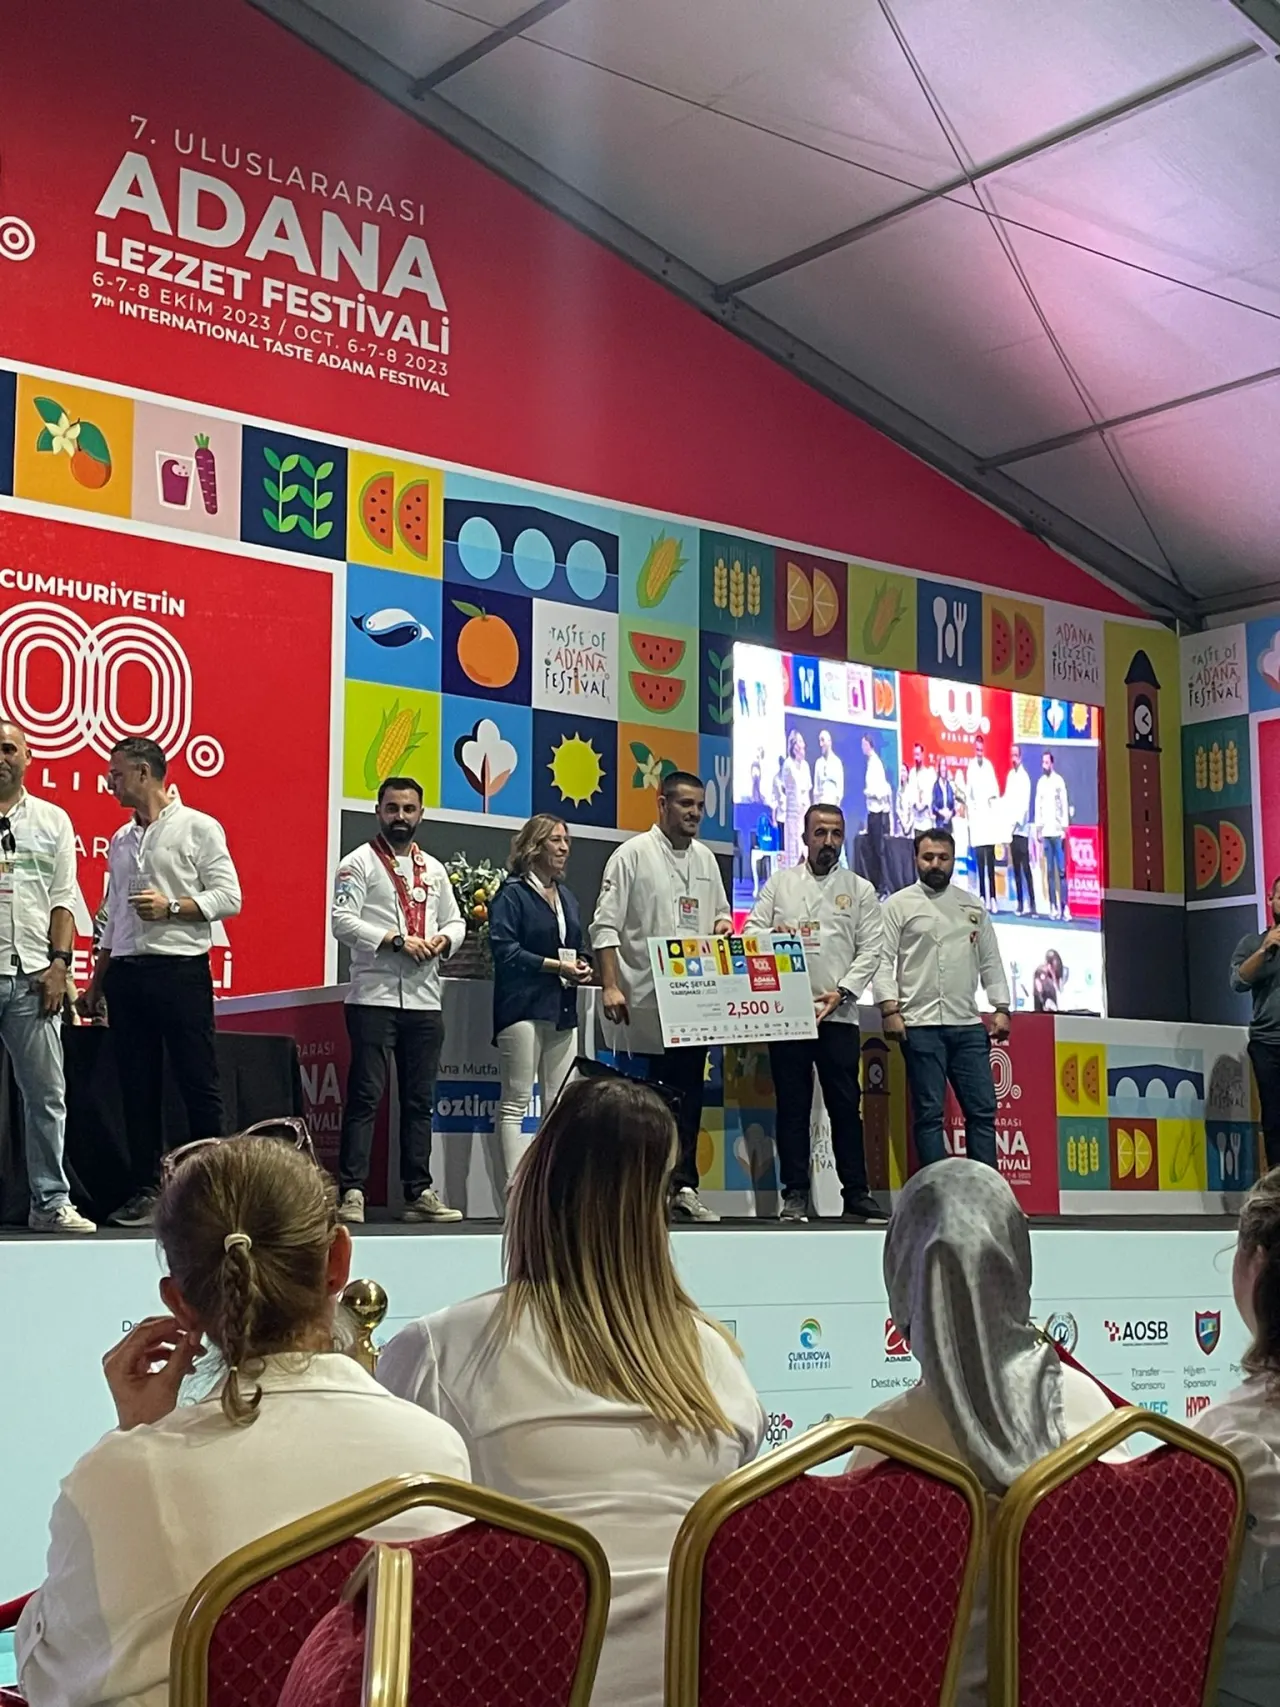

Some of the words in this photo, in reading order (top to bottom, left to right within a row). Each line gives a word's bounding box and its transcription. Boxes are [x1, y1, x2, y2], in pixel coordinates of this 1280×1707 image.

[130, 114, 156, 144] 7.
[174, 128, 426, 226] ULUSLARARASI
[94, 150, 449, 312] ADANA
[95, 231, 251, 301] LEZZET
[261, 279, 450, 355] FESTİVALİ
[92, 271, 150, 300] 6-7-8
[159, 288, 214, 317] EKİM
[222, 304, 271, 332] 2023
[293, 324, 340, 350] OCT.
[347, 337, 397, 364] 6-7-8
[404, 351, 449, 377] 2023
[91, 292, 115, 309] 7th
[118, 299, 260, 350] INTERNATIONAL
[262, 337, 314, 364] TASTE
[317, 353, 376, 379] ADANA
[379, 368, 450, 397] FESTIVAL
[0, 568, 186, 618] CUMHURİYETİN
[554, 647, 606, 673] ADANA
[726, 1000, 770, 1018] 2,500
[463, 1063, 500, 1075] Mutfa
[1122, 1321, 1169, 1341] AOSB
[788, 1351, 831, 1363] ÇUKUROVA
[1131, 1367, 1160, 1377] Transfer
[871, 1378, 901, 1389] Destek
[1131, 1381, 1166, 1391] Sponsoru
[1183, 1379, 1217, 1388] Sponsoru
